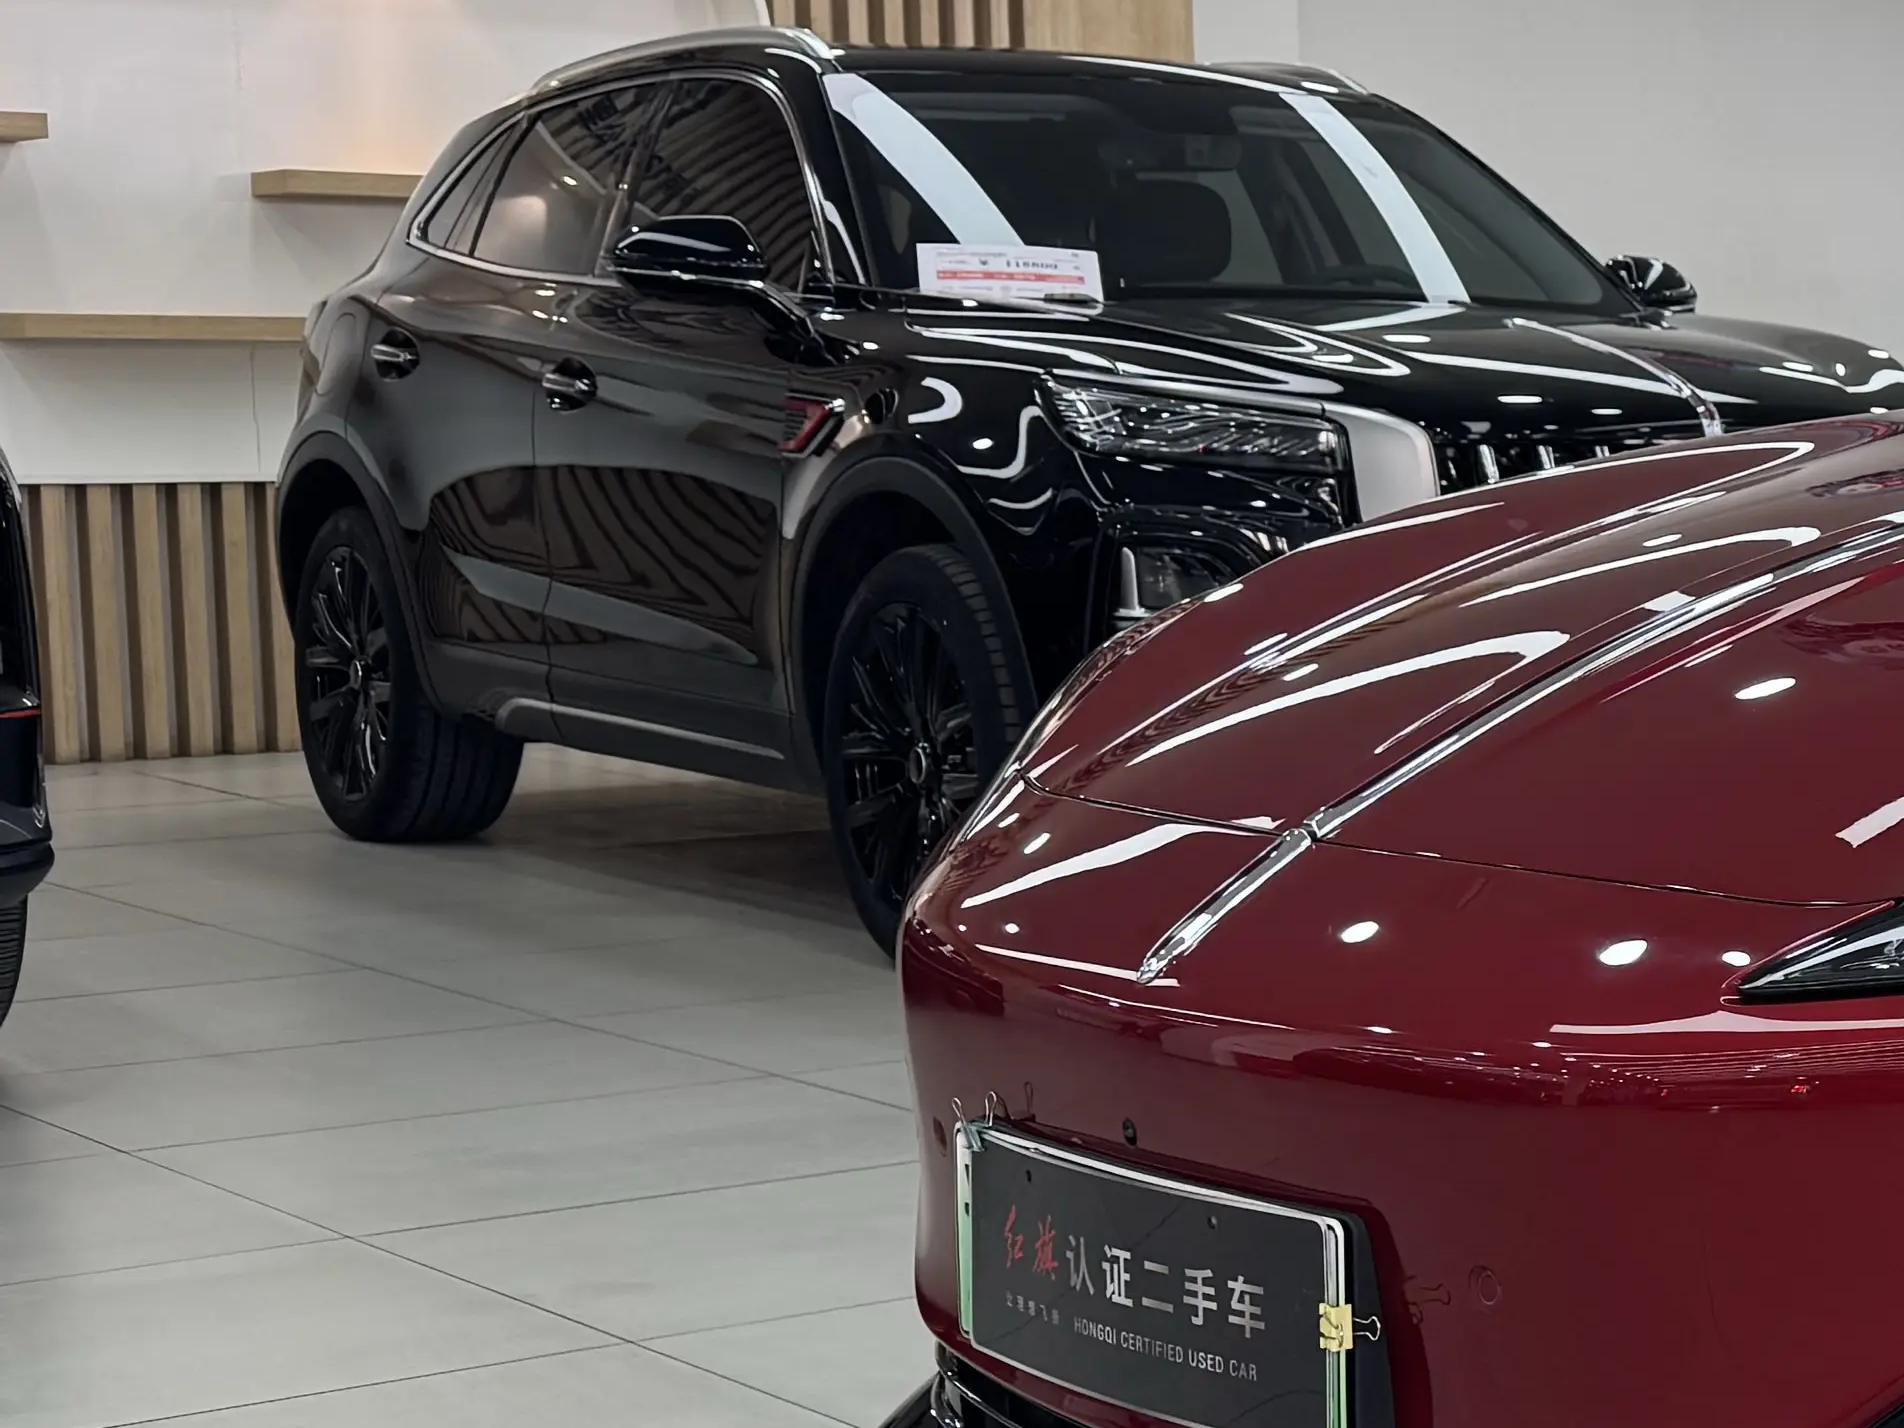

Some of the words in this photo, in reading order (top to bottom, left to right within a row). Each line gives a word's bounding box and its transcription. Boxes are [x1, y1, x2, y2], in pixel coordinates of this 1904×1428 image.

[1073, 1317, 1117, 1345] HONGQI
[1120, 1332, 1184, 1363] CERTIFIED
[1188, 1349, 1224, 1373] USED
[1229, 1359, 1258, 1381] CAR
